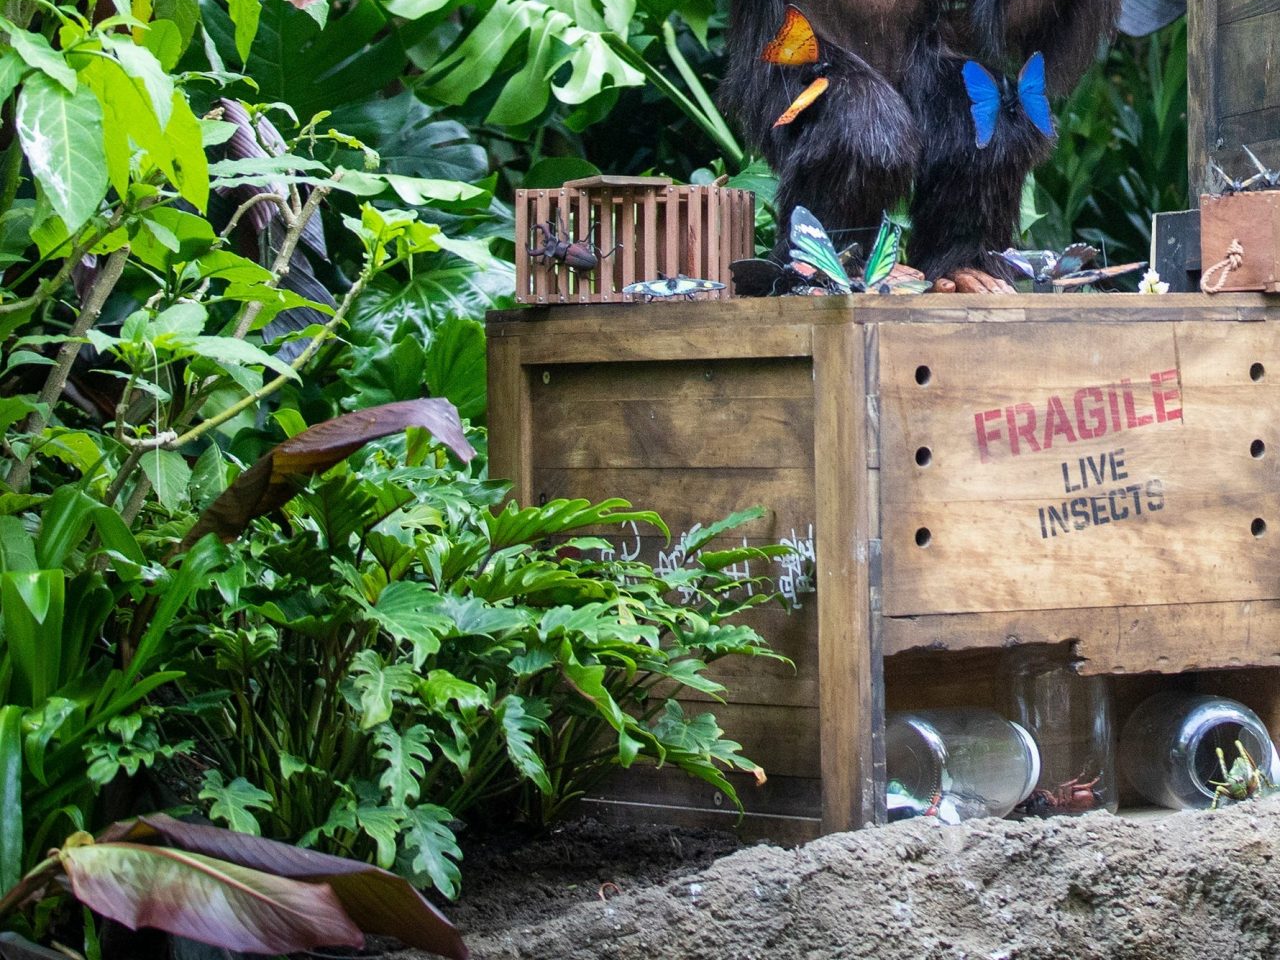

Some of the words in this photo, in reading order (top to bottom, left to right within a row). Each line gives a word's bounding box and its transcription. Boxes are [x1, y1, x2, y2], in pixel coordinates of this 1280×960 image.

[974, 369, 1183, 464] FRAGILE
[1061, 448, 1129, 493] LIVE
[1038, 479, 1165, 539] INSECTS
